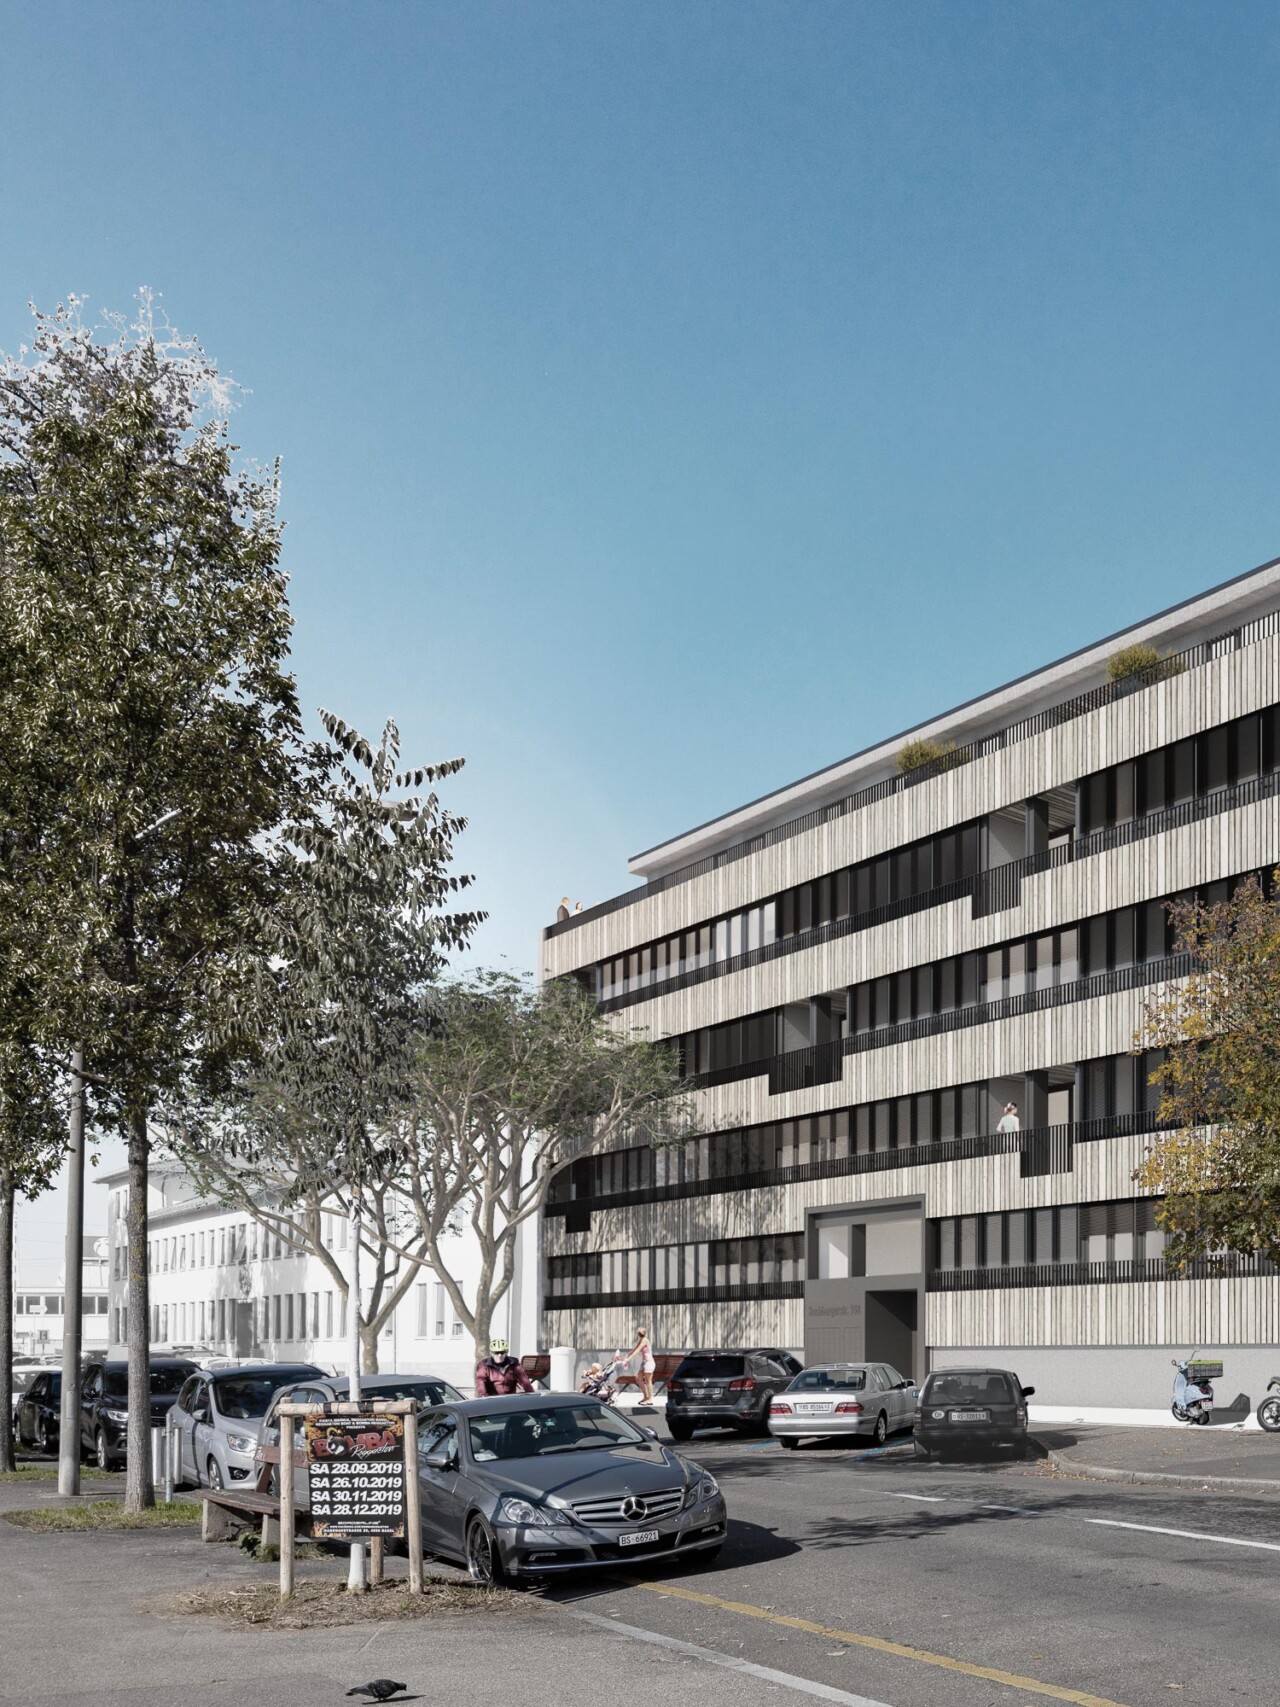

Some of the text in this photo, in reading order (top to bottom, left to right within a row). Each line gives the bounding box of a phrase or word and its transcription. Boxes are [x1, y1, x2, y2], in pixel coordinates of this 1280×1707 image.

[309, 1463, 403, 1474] SA 28.09.2019
[310, 1477, 403, 1488] SA 26.10.2019
[311, 1490, 403, 1502] SA 30.11.2019
[311, 1504, 403, 1515] SA 28.12.2019
